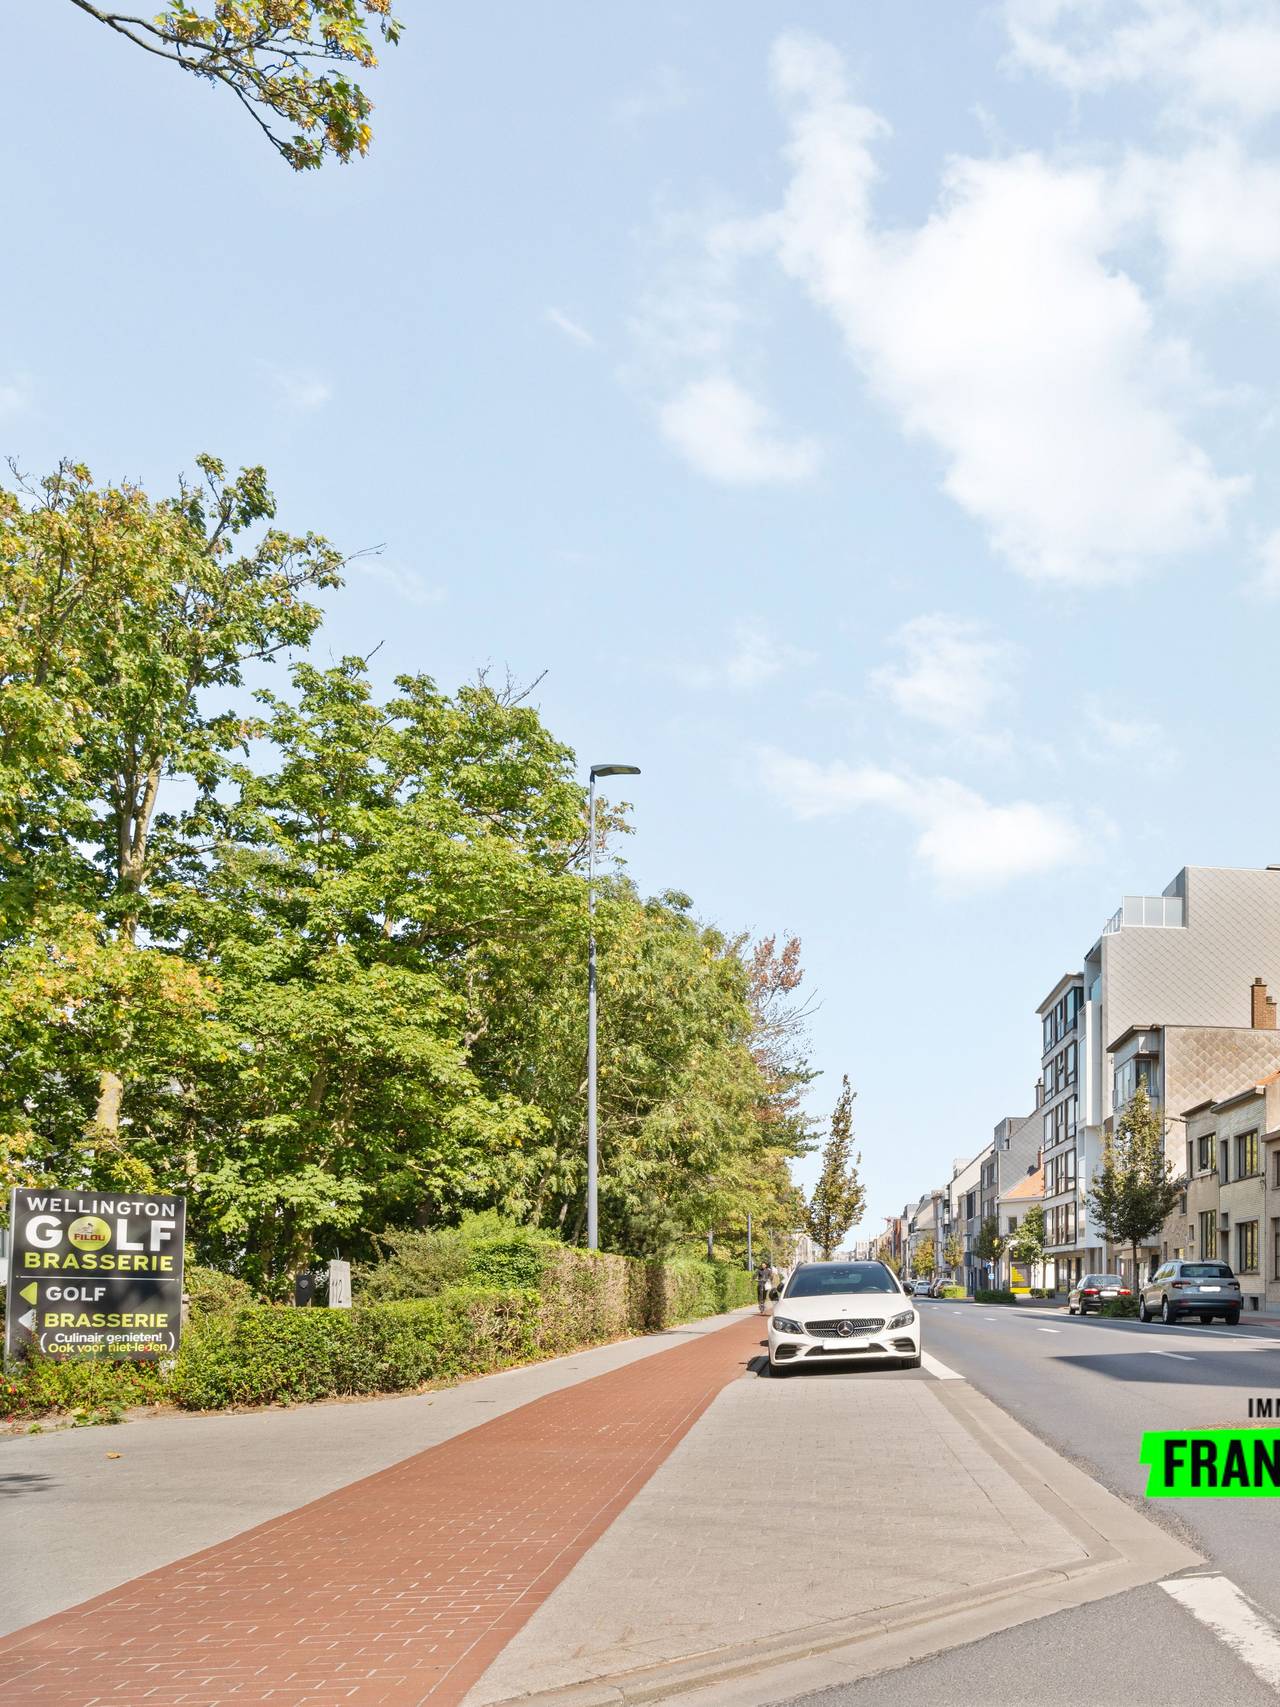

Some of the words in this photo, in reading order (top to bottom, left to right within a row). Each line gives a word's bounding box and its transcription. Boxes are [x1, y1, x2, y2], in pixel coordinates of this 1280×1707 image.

[27, 1197, 175, 1217] WELLINGTON
[74, 1233, 106, 1242] FILOU
[24, 1252, 173, 1271] BRASSERIE
[45, 1286, 107, 1302] GOLF
[44, 1312, 169, 1328] BRASSERIE
[55, 1332, 104, 1343] Culinair
[106, 1332, 163, 1345] genieten!
[48, 1343, 75, 1353] Ook
[76, 1344, 105, 1353] voor
